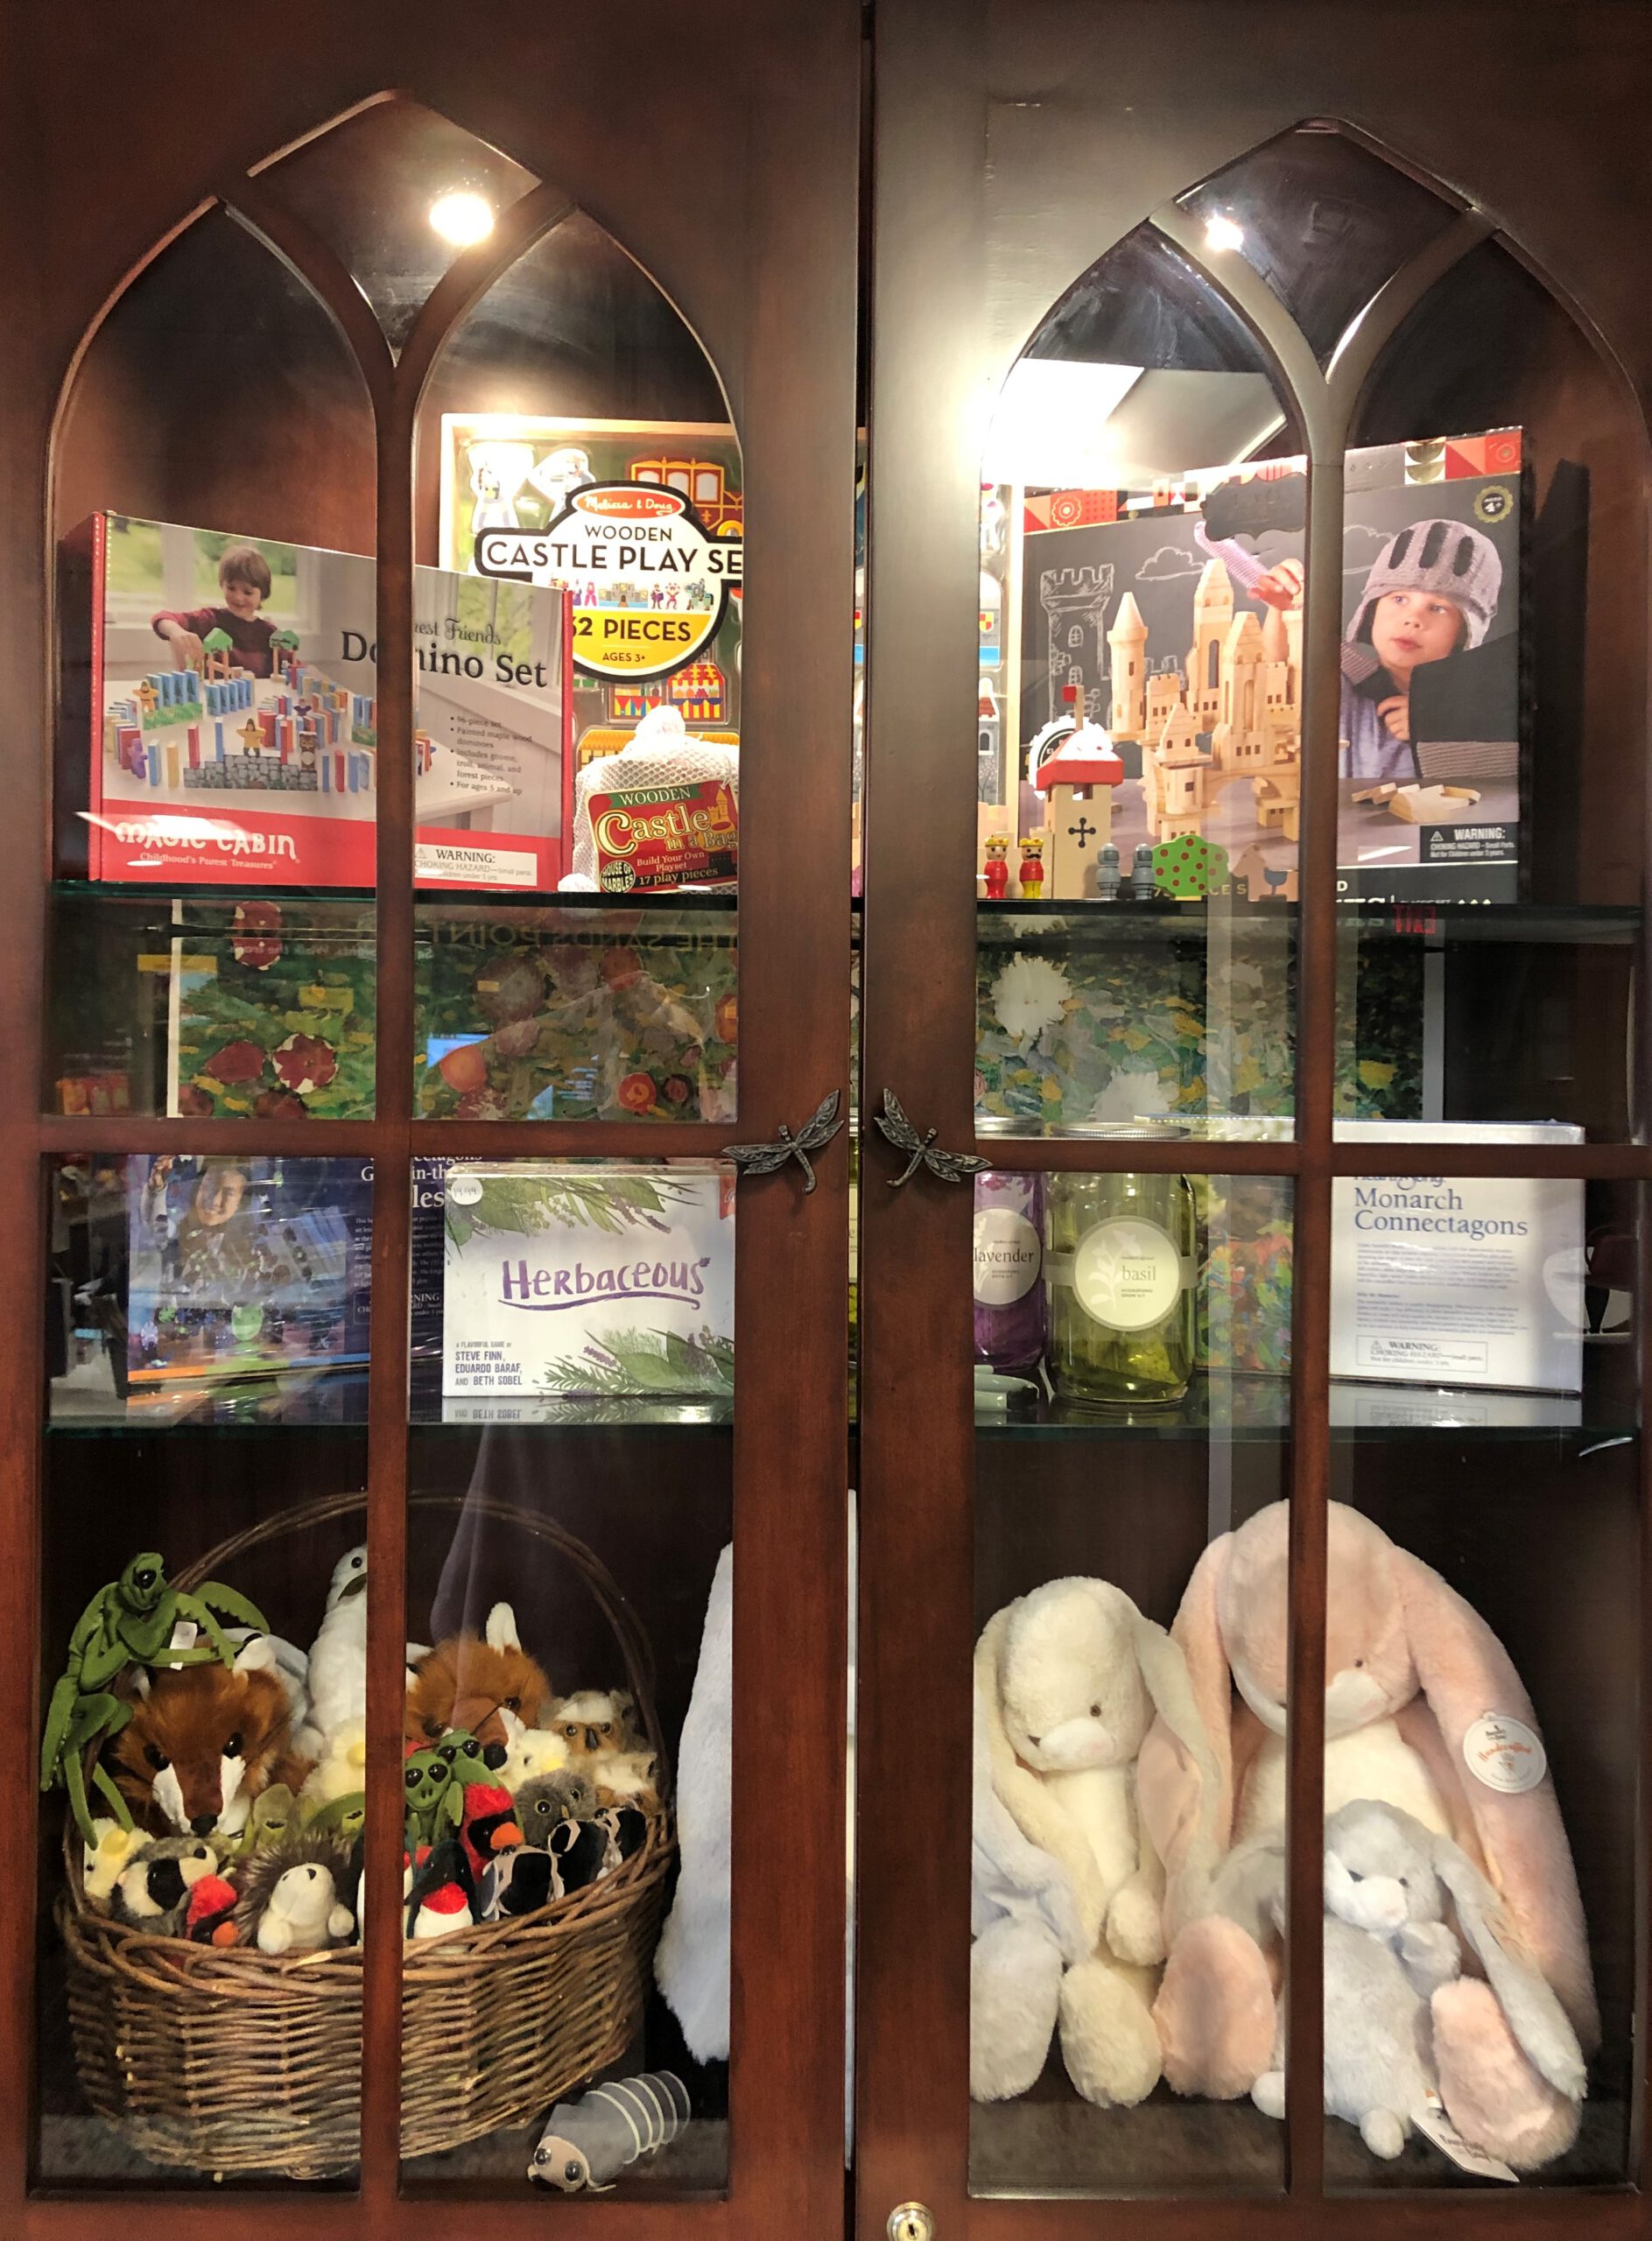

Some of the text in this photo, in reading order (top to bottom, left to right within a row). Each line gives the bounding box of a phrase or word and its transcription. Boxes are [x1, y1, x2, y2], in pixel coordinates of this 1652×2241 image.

[585, 495, 632, 511] Melissa
[645, 498, 673, 516] Doug
[585, 525, 672, 541] WOODEN
[487, 540, 742, 574] CASTLE PLAY SE
[445, 617, 502, 646] Friends
[603, 618, 691, 641] PIECES
[602, 652, 631, 662] AGES
[496, 654, 547, 687] Set
[457, 770, 478, 779] forest
[496, 784, 510, 793] and
[618, 786, 692, 806] WOODEN
[595, 802, 712, 857] Castle
[1453, 826, 1506, 840] WARNING:
[216, 829, 297, 860] CABIN
[664, 832, 738, 851] in a Bag
[140, 852, 274, 870] Childhood's Purest Treasures
[415, 860, 454, 870] CHOKING
[435, 849, 496, 864] WARNING:
[636, 854, 660, 867] Build
[661, 854, 683, 863] Your
[601, 862, 632, 876] HOUSE OF
[656, 861, 687, 873] Playset
[601, 875, 634, 894] MARBLES
[639, 867, 719, 886] 17 play pieces
[1354, 1187, 1464, 1210] Monarch
[1354, 1209, 1529, 1240] Connectagons
[973, 1247, 1035, 1263] lavender
[502, 1257, 712, 1300] Herbaceous
[1121, 1265, 1156, 1282] basil
[1388, 1340, 1440, 1352] WARNING:
[455, 1351, 506, 1362] STEVE FINN,
[455, 1363, 523, 1375] EDUARDO BARAF,
[455, 1375, 523, 1386] AND BETH SOBEL
